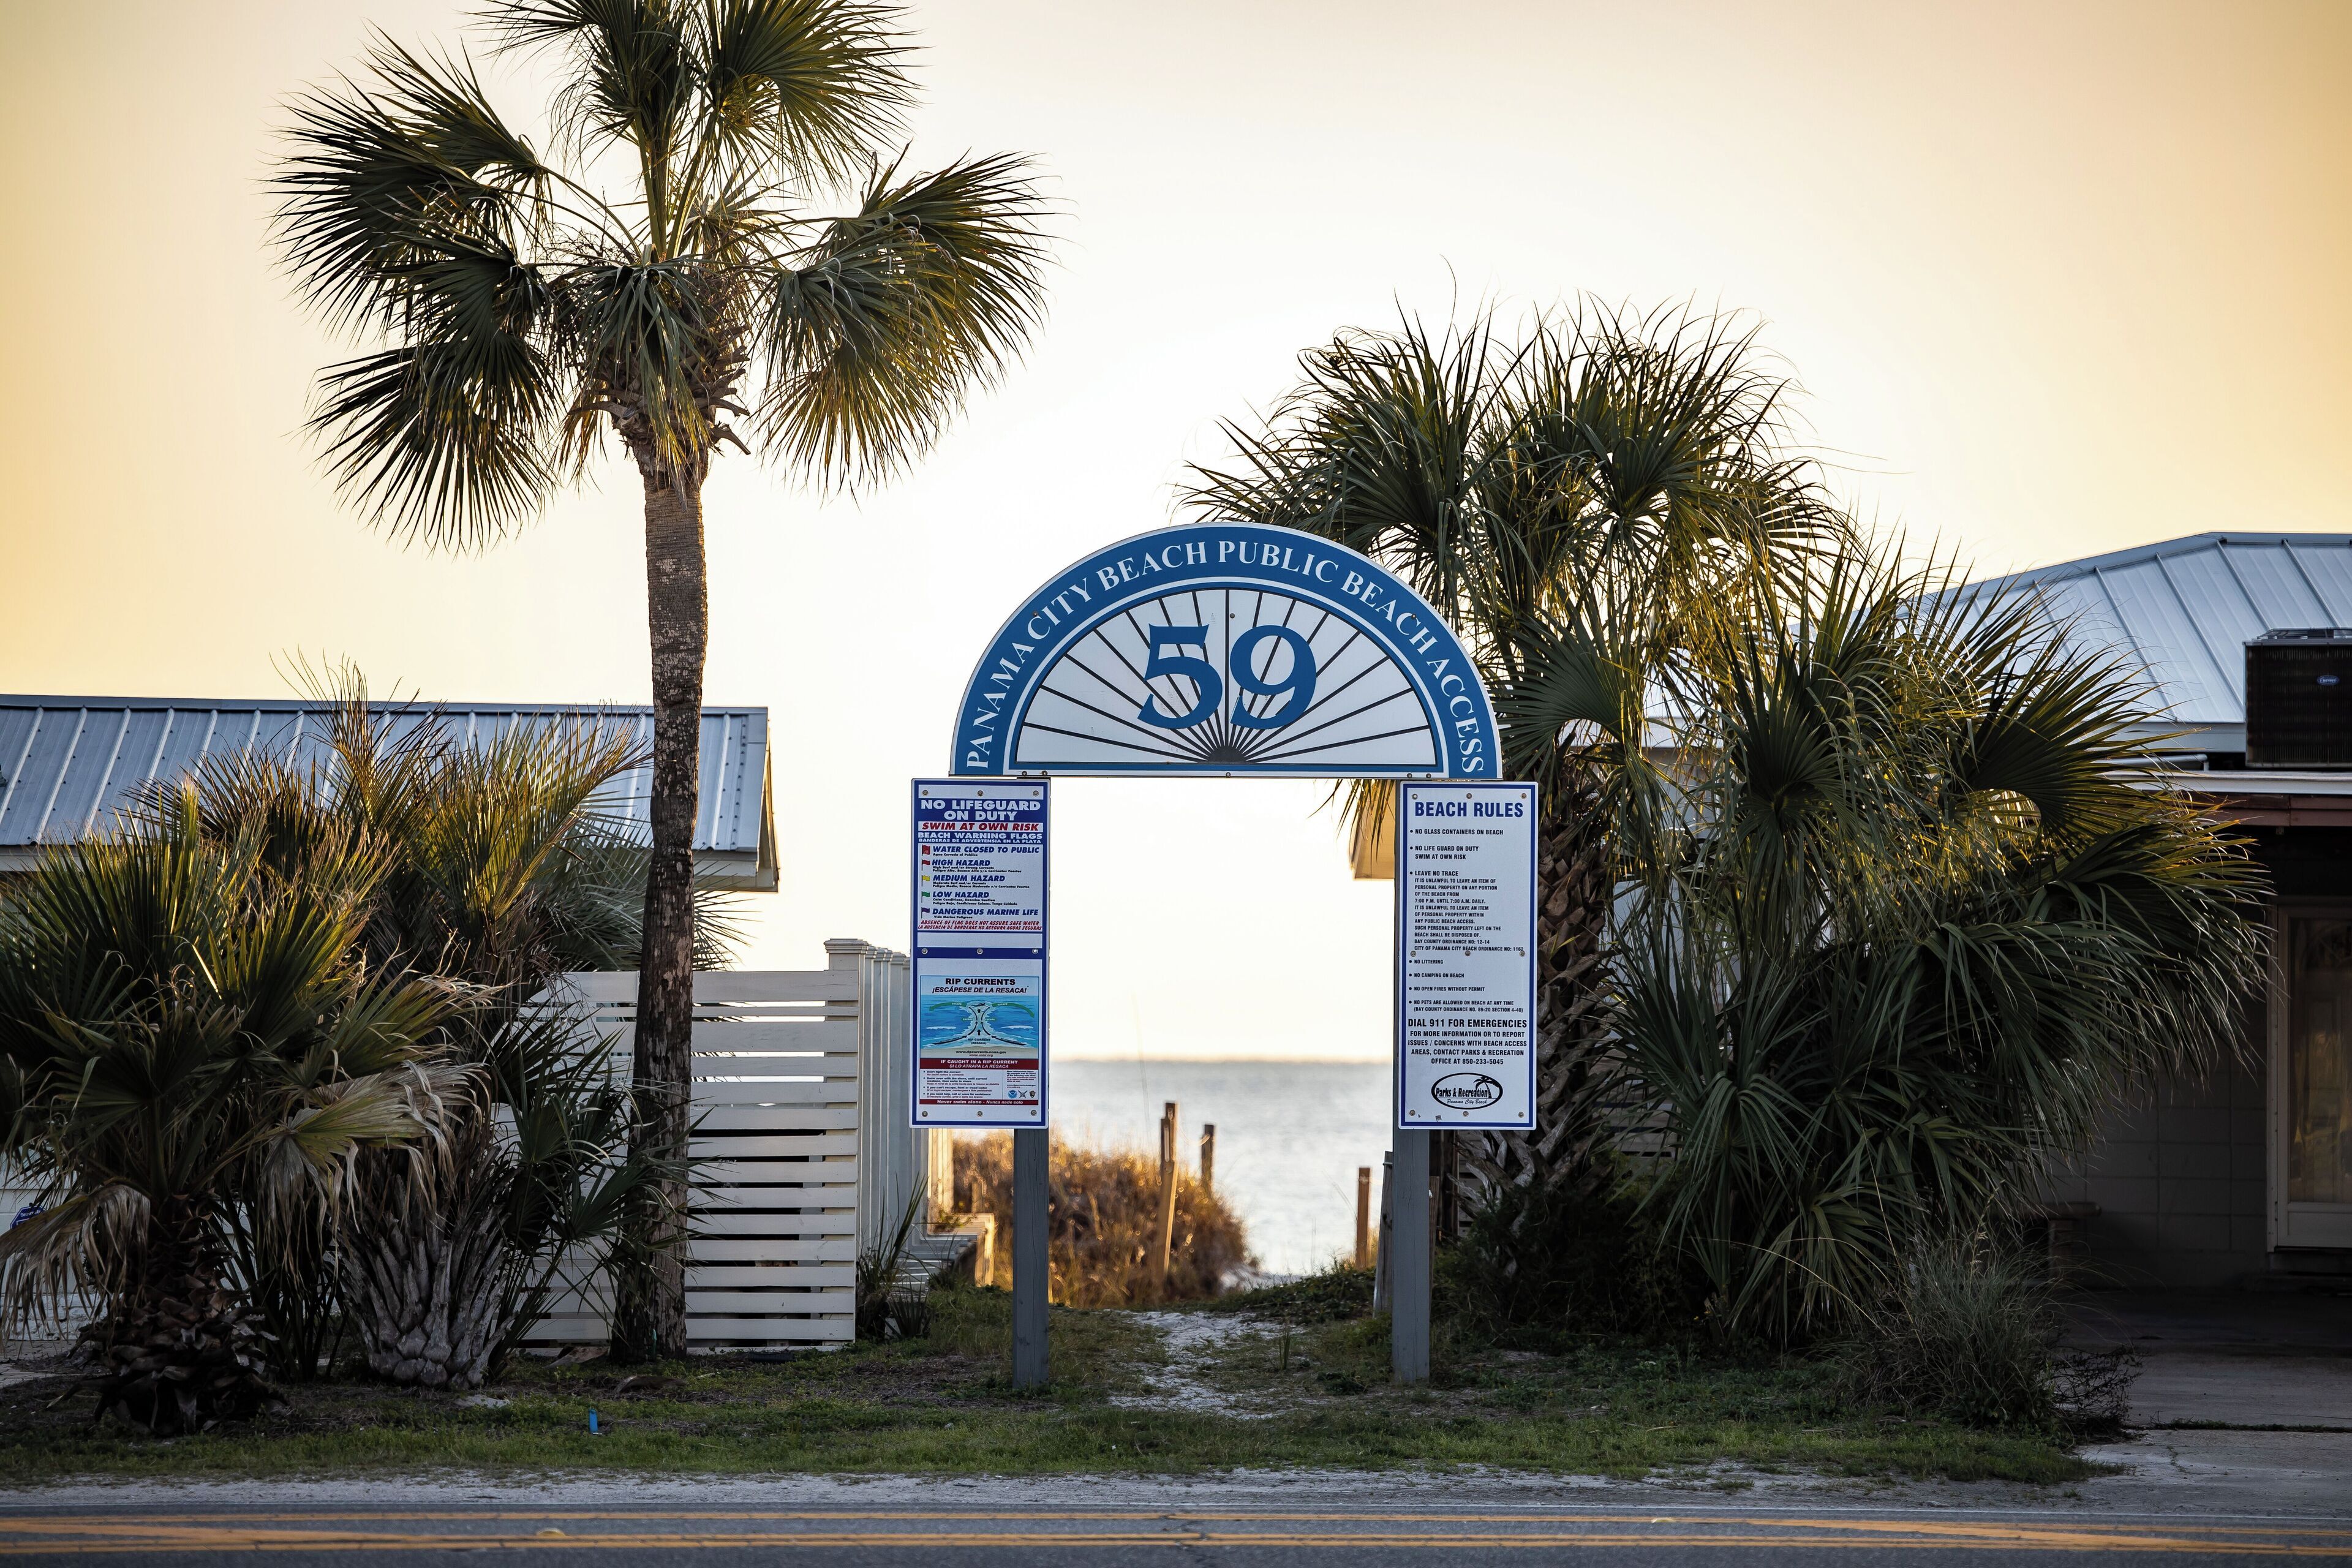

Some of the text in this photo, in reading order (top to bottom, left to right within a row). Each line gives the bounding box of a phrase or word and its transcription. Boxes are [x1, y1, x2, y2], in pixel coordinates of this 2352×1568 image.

[967, 541, 1484, 774] PANAMA CITY BEACH PUBLIC BEACH ACCESS
[1137, 623, 1317, 730] 59
[921, 800, 1041, 810] NO LIFEGUARD
[1415, 802, 1523, 818] BEACH RULES
[944, 810, 1017, 821] ON DUTY
[1430, 1019, 1444, 1027] 911
[1468, 1019, 1527, 1028] EMERGENCIES
[1436, 1087, 1488, 1098] Parks & Recreation
